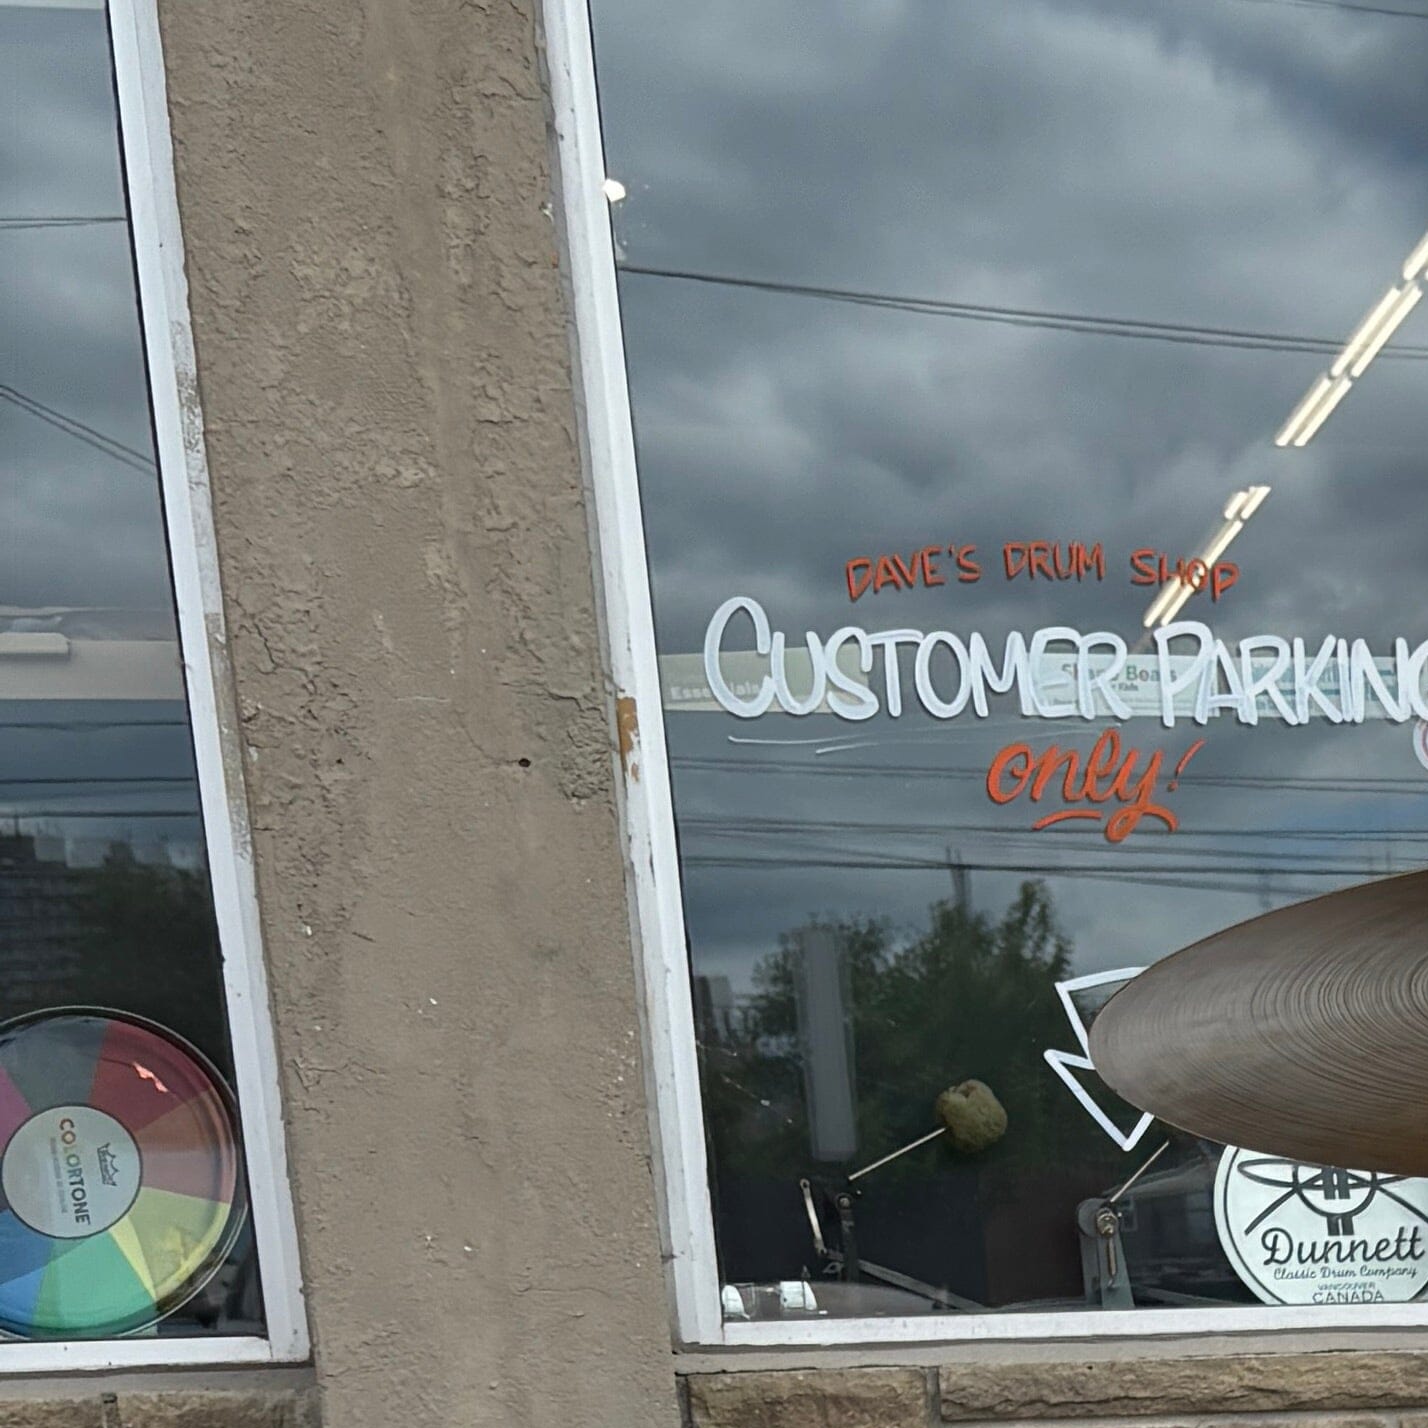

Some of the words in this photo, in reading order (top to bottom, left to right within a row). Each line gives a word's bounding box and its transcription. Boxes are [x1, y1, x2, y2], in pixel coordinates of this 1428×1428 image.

[846, 543, 982, 601] DAVE'S
[1003, 541, 1106, 583] DRUM
[1130, 547, 1241, 601] SHOP
[704, 596, 1133, 720] CUSTOMER
[1126, 664, 1178, 682] Beas
[985, 727, 1208, 844] only!
[1261, 1225, 1426, 1266] Dunnett
[1274, 1265, 1316, 1281] Classic
[1320, 1267, 1357, 1279] Drum
[1360, 1264, 1419, 1280] Company
[1312, 1290, 1385, 1304] CANADA
